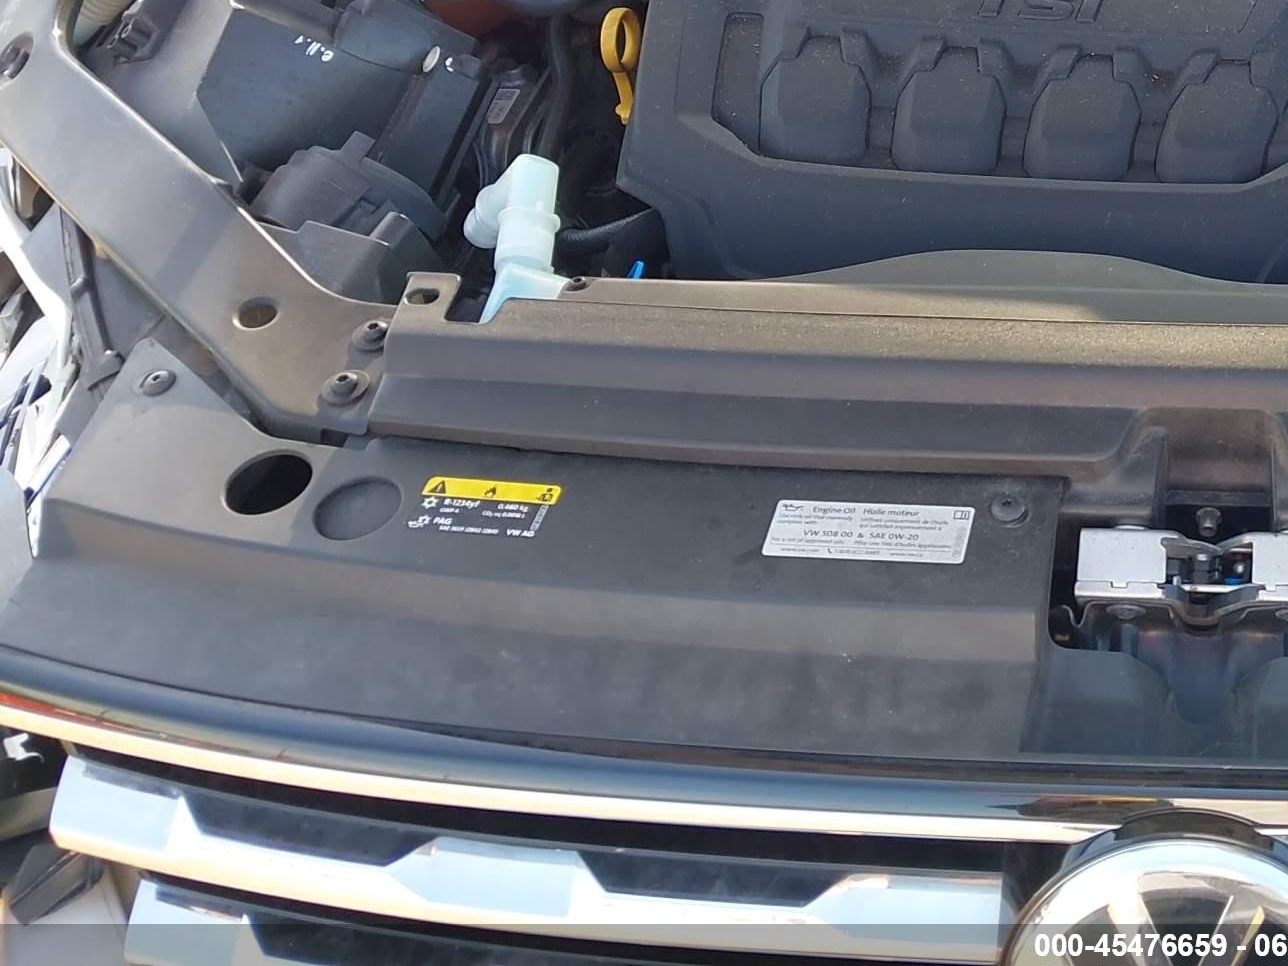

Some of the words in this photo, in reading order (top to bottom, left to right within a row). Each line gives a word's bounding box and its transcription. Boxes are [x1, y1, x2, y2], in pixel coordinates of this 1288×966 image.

[812, 506, 842, 515] Engine
[432, 516, 453, 525] PAG
[506, 528, 521, 537] VW
[521, 530, 535, 538] AG
[803, 529, 821, 537] VW
[888, 532, 920, 541] 0W-20
